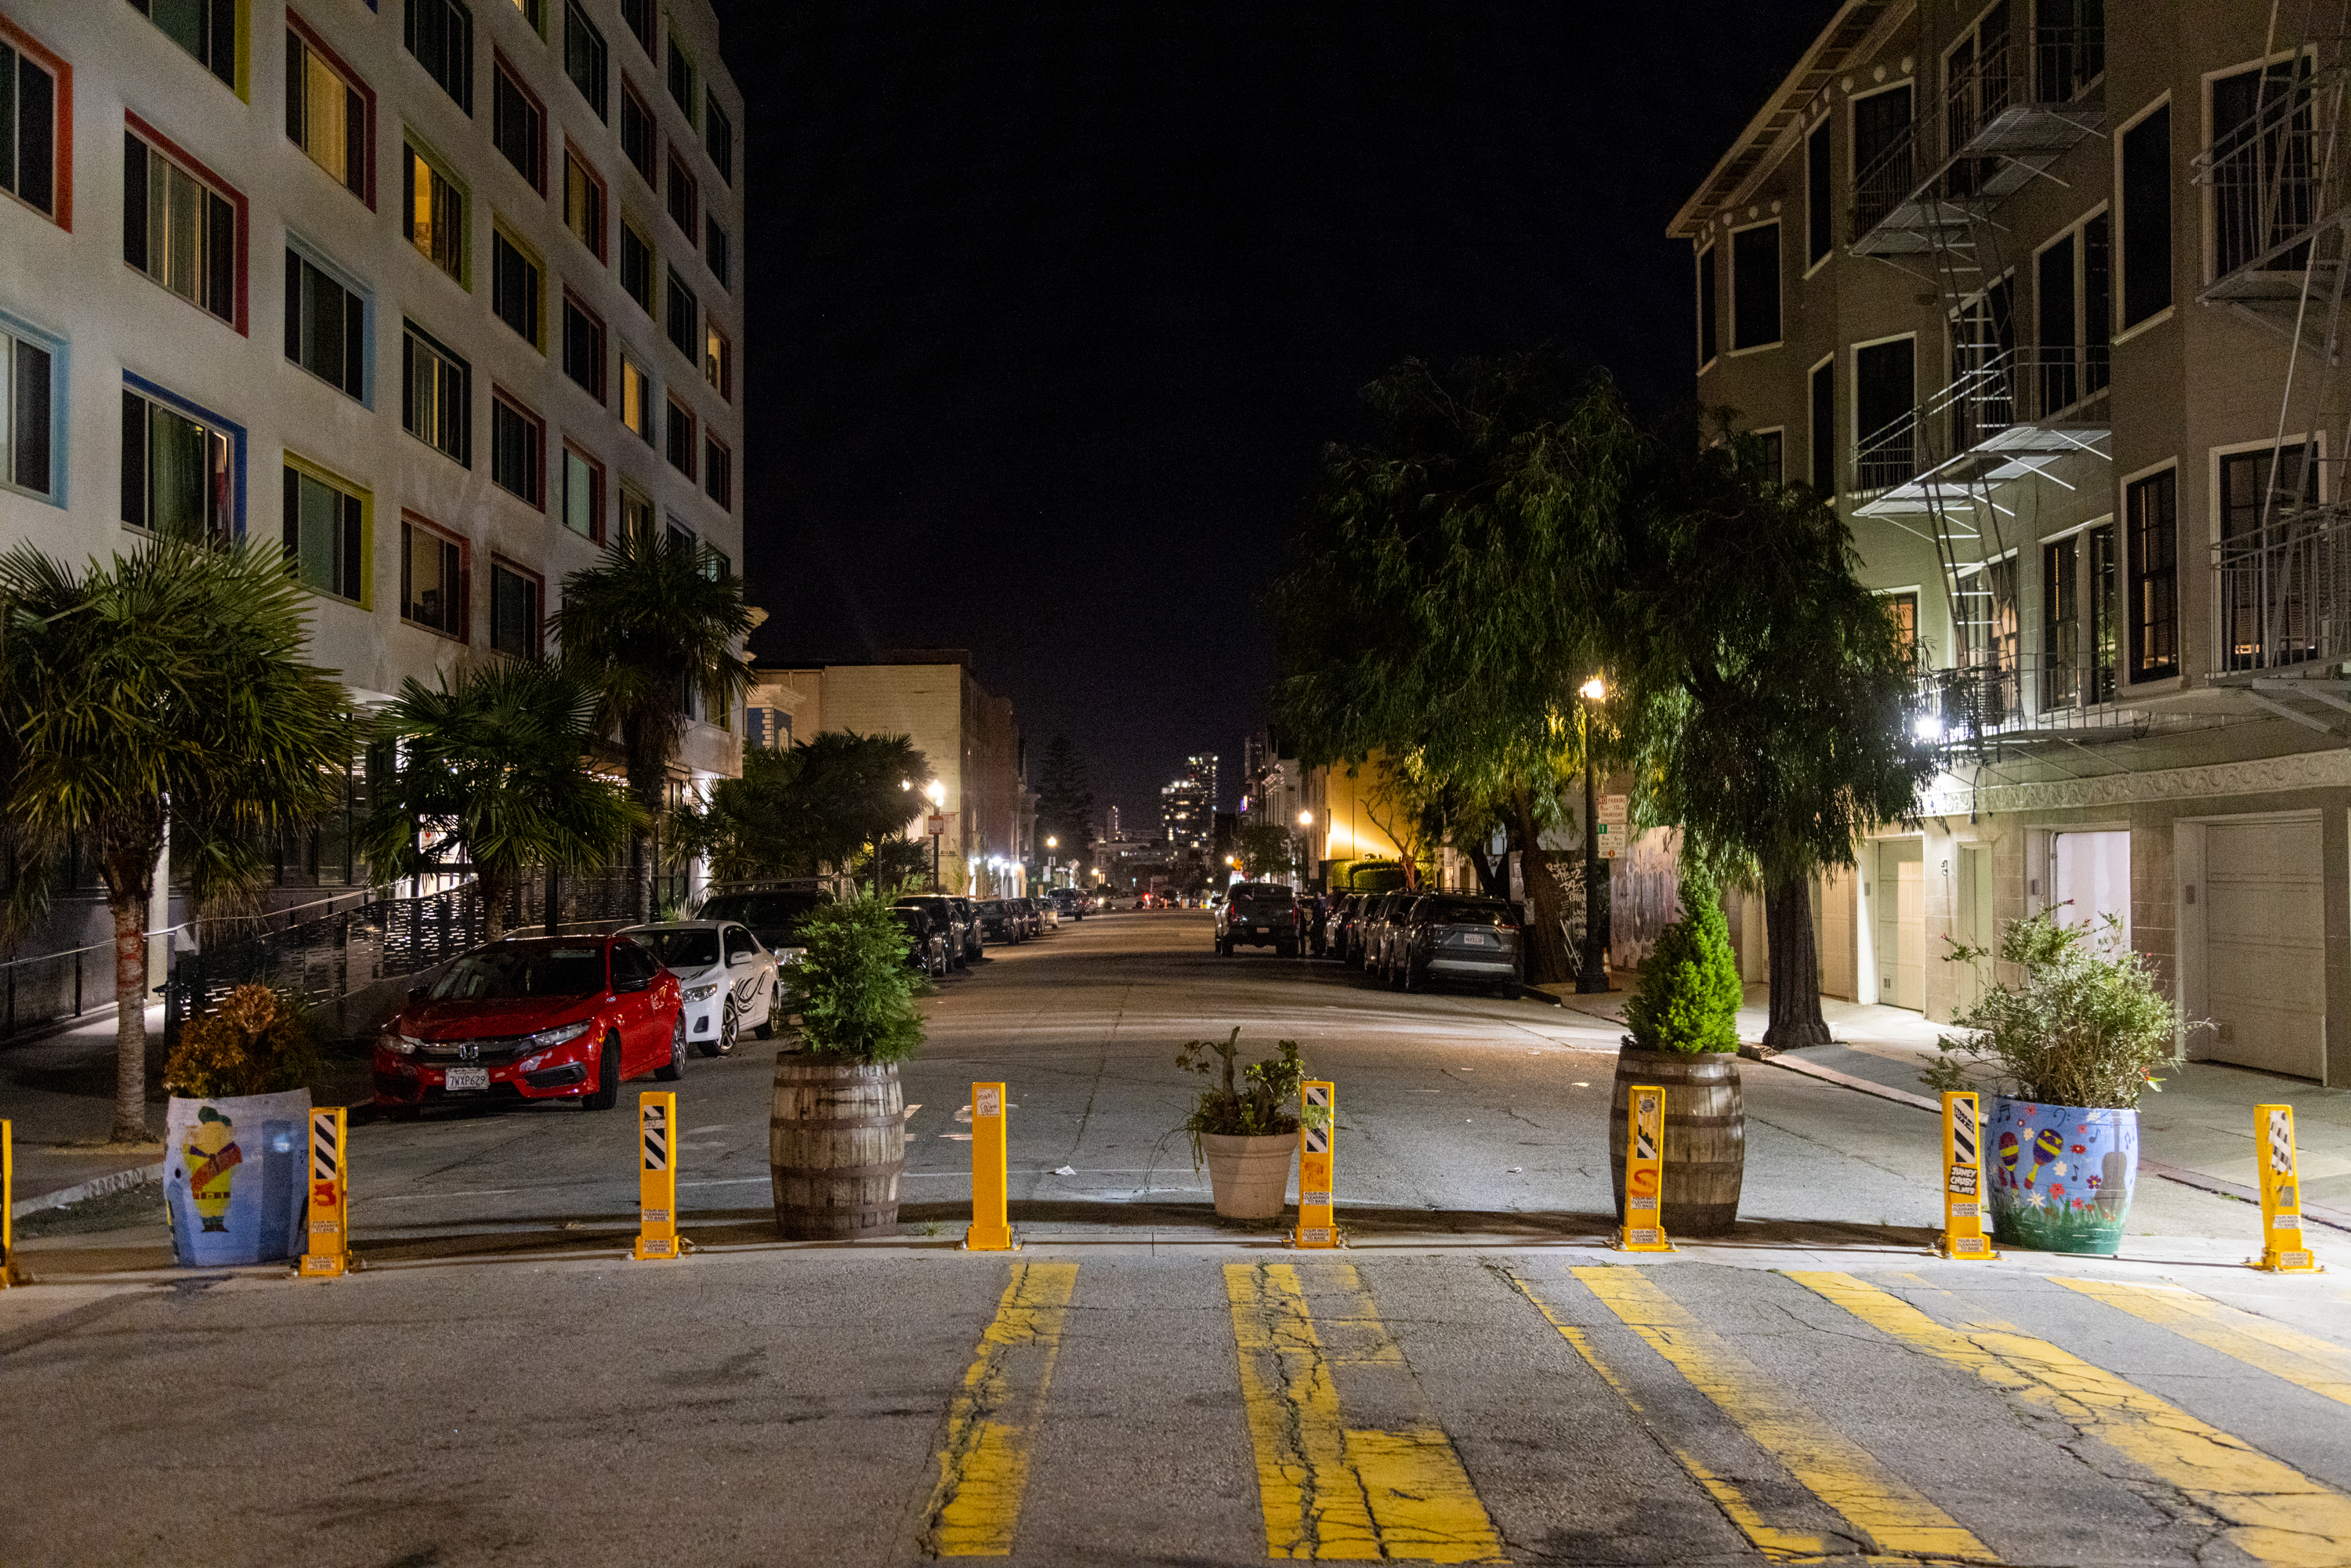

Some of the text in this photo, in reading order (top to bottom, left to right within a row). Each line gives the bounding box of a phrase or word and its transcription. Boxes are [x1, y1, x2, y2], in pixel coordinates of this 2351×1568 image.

[450, 1075, 485, 1087] 7WXP629
[1951, 1167, 1977, 1178] JUNEY
[1950, 1176, 1976, 1186] CHUBY
